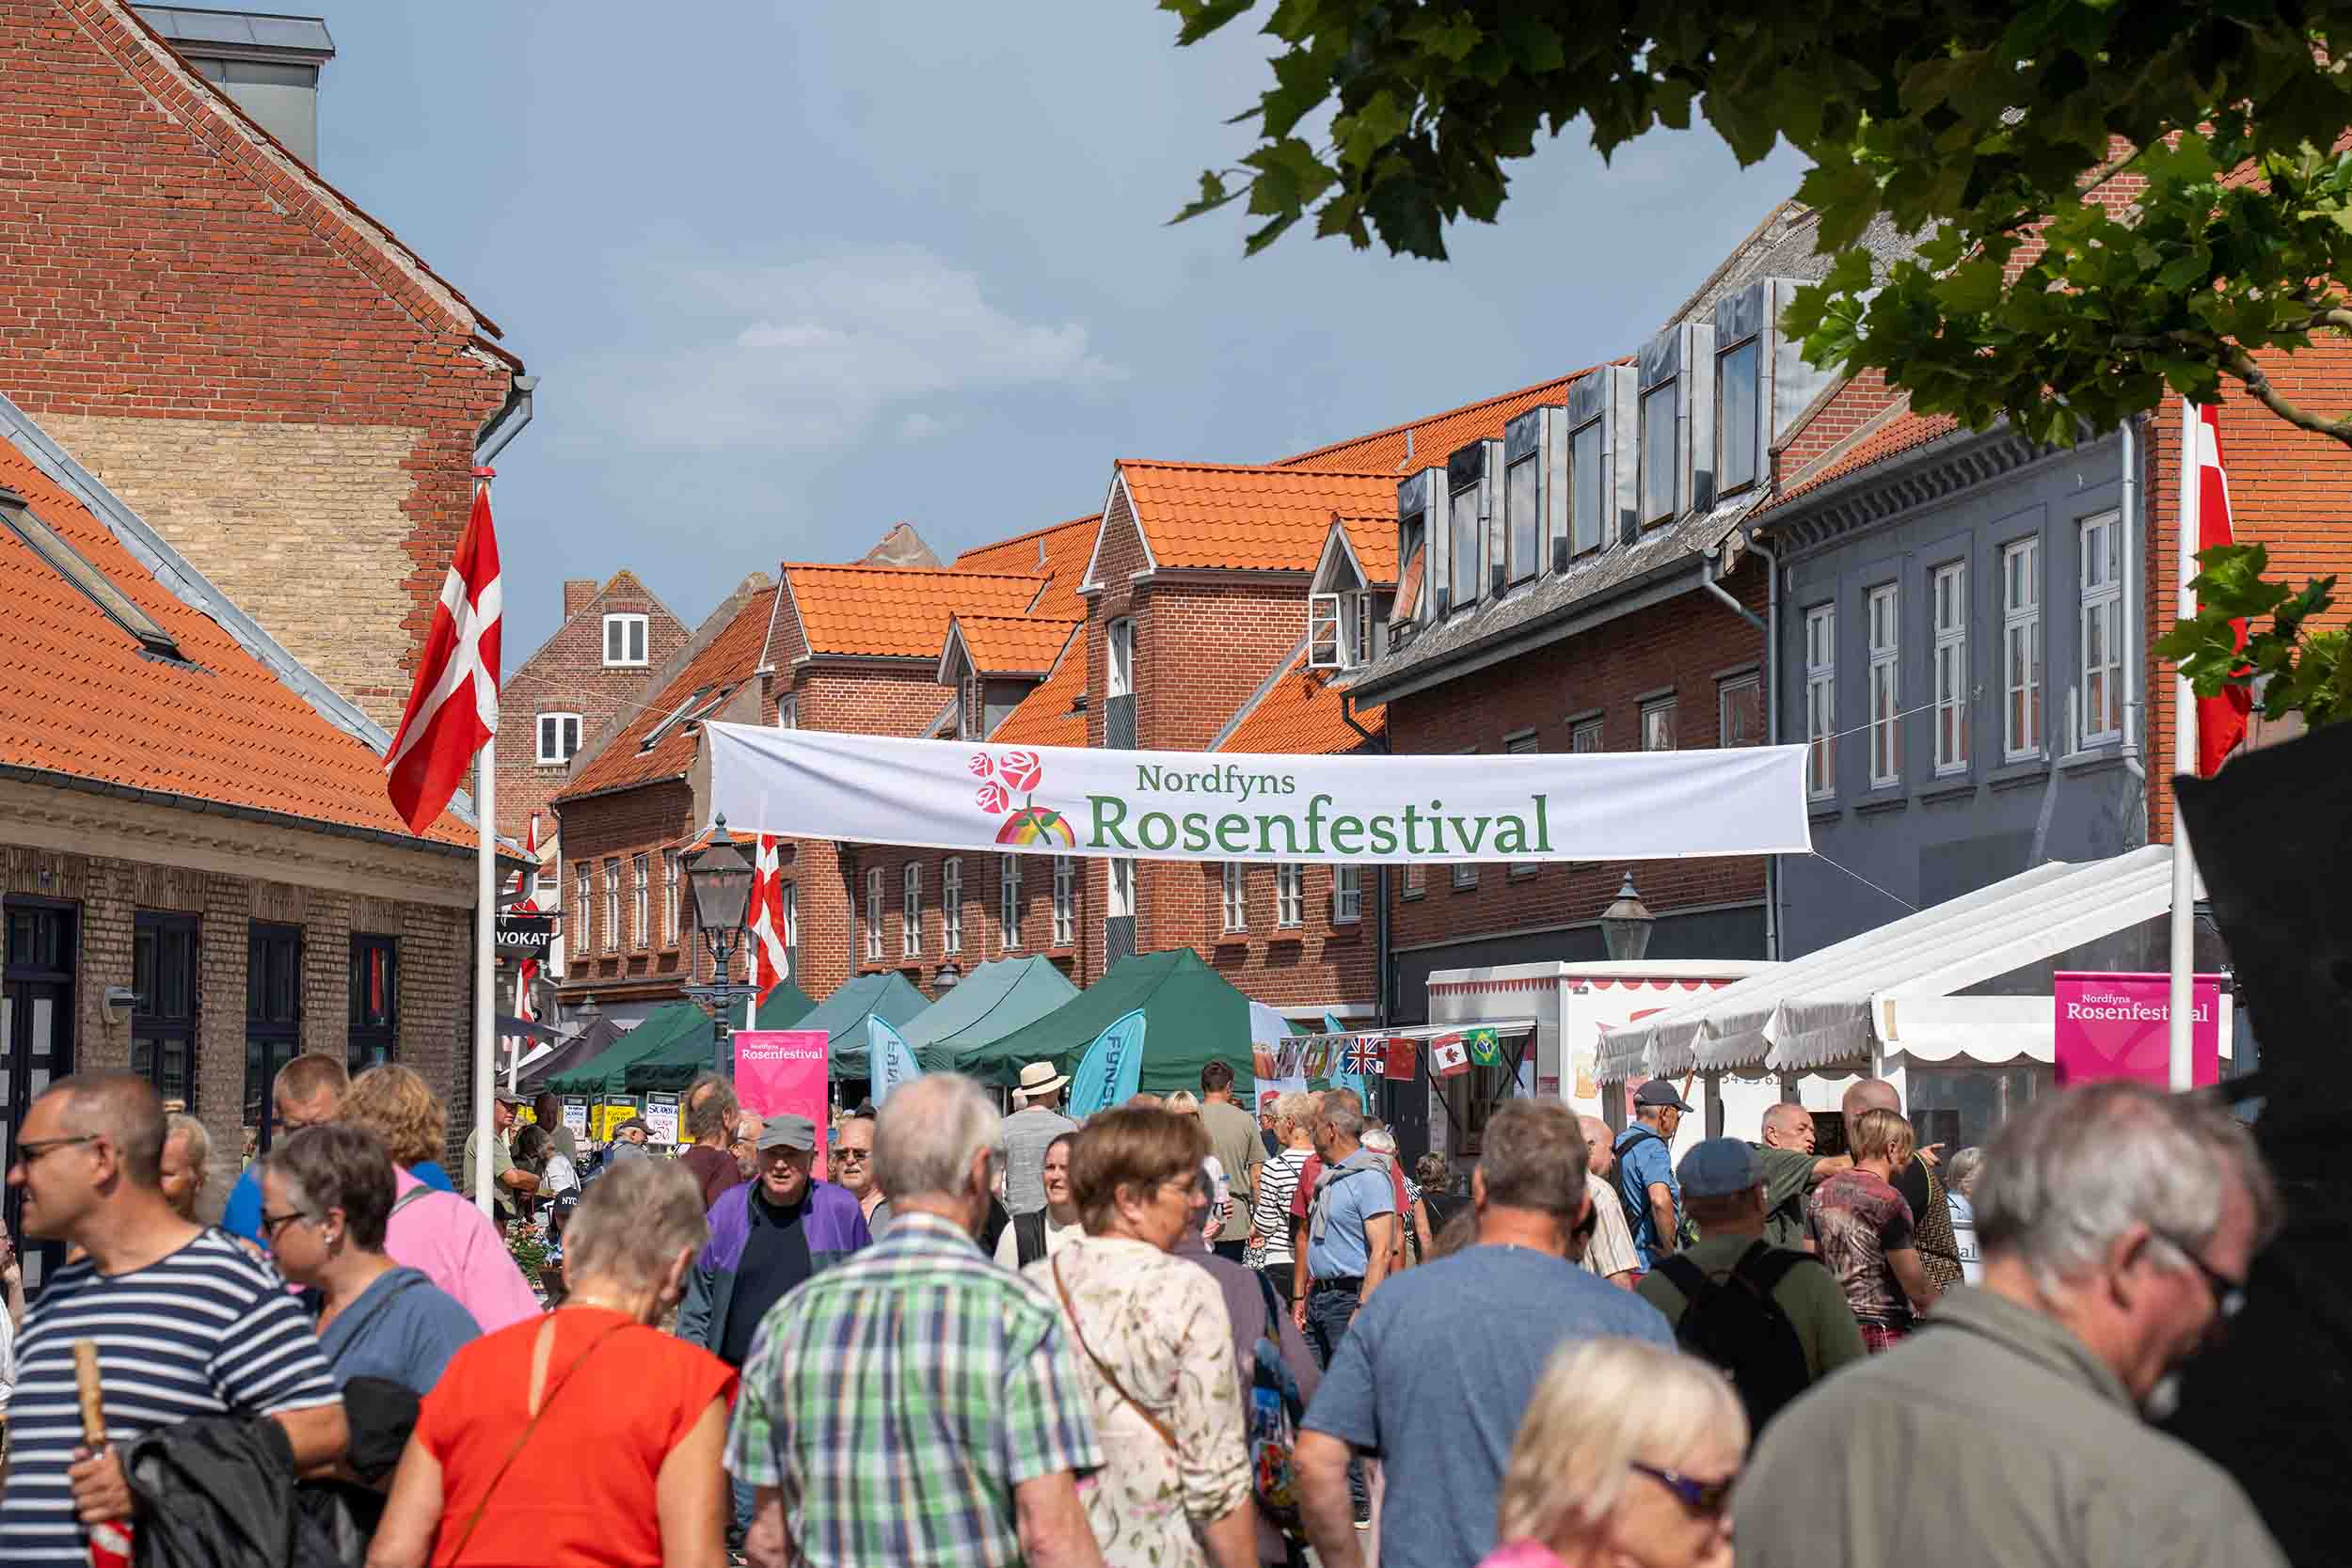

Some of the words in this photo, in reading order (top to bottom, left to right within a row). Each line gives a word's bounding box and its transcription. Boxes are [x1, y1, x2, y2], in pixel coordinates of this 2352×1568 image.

[1136, 764, 1295, 803] Nordfyns
[1085, 793, 1555, 855] Rosenfestival
[496, 931, 550, 945] VOKAT
[2081, 993, 2131, 1006] Nordfyns
[2066, 1002, 2209, 1022] Rosenfestal
[741, 1047, 823, 1060] Rosenfestival
[562, 1196, 578, 1206] NYC
[1959, 1242, 1979, 1259] al
